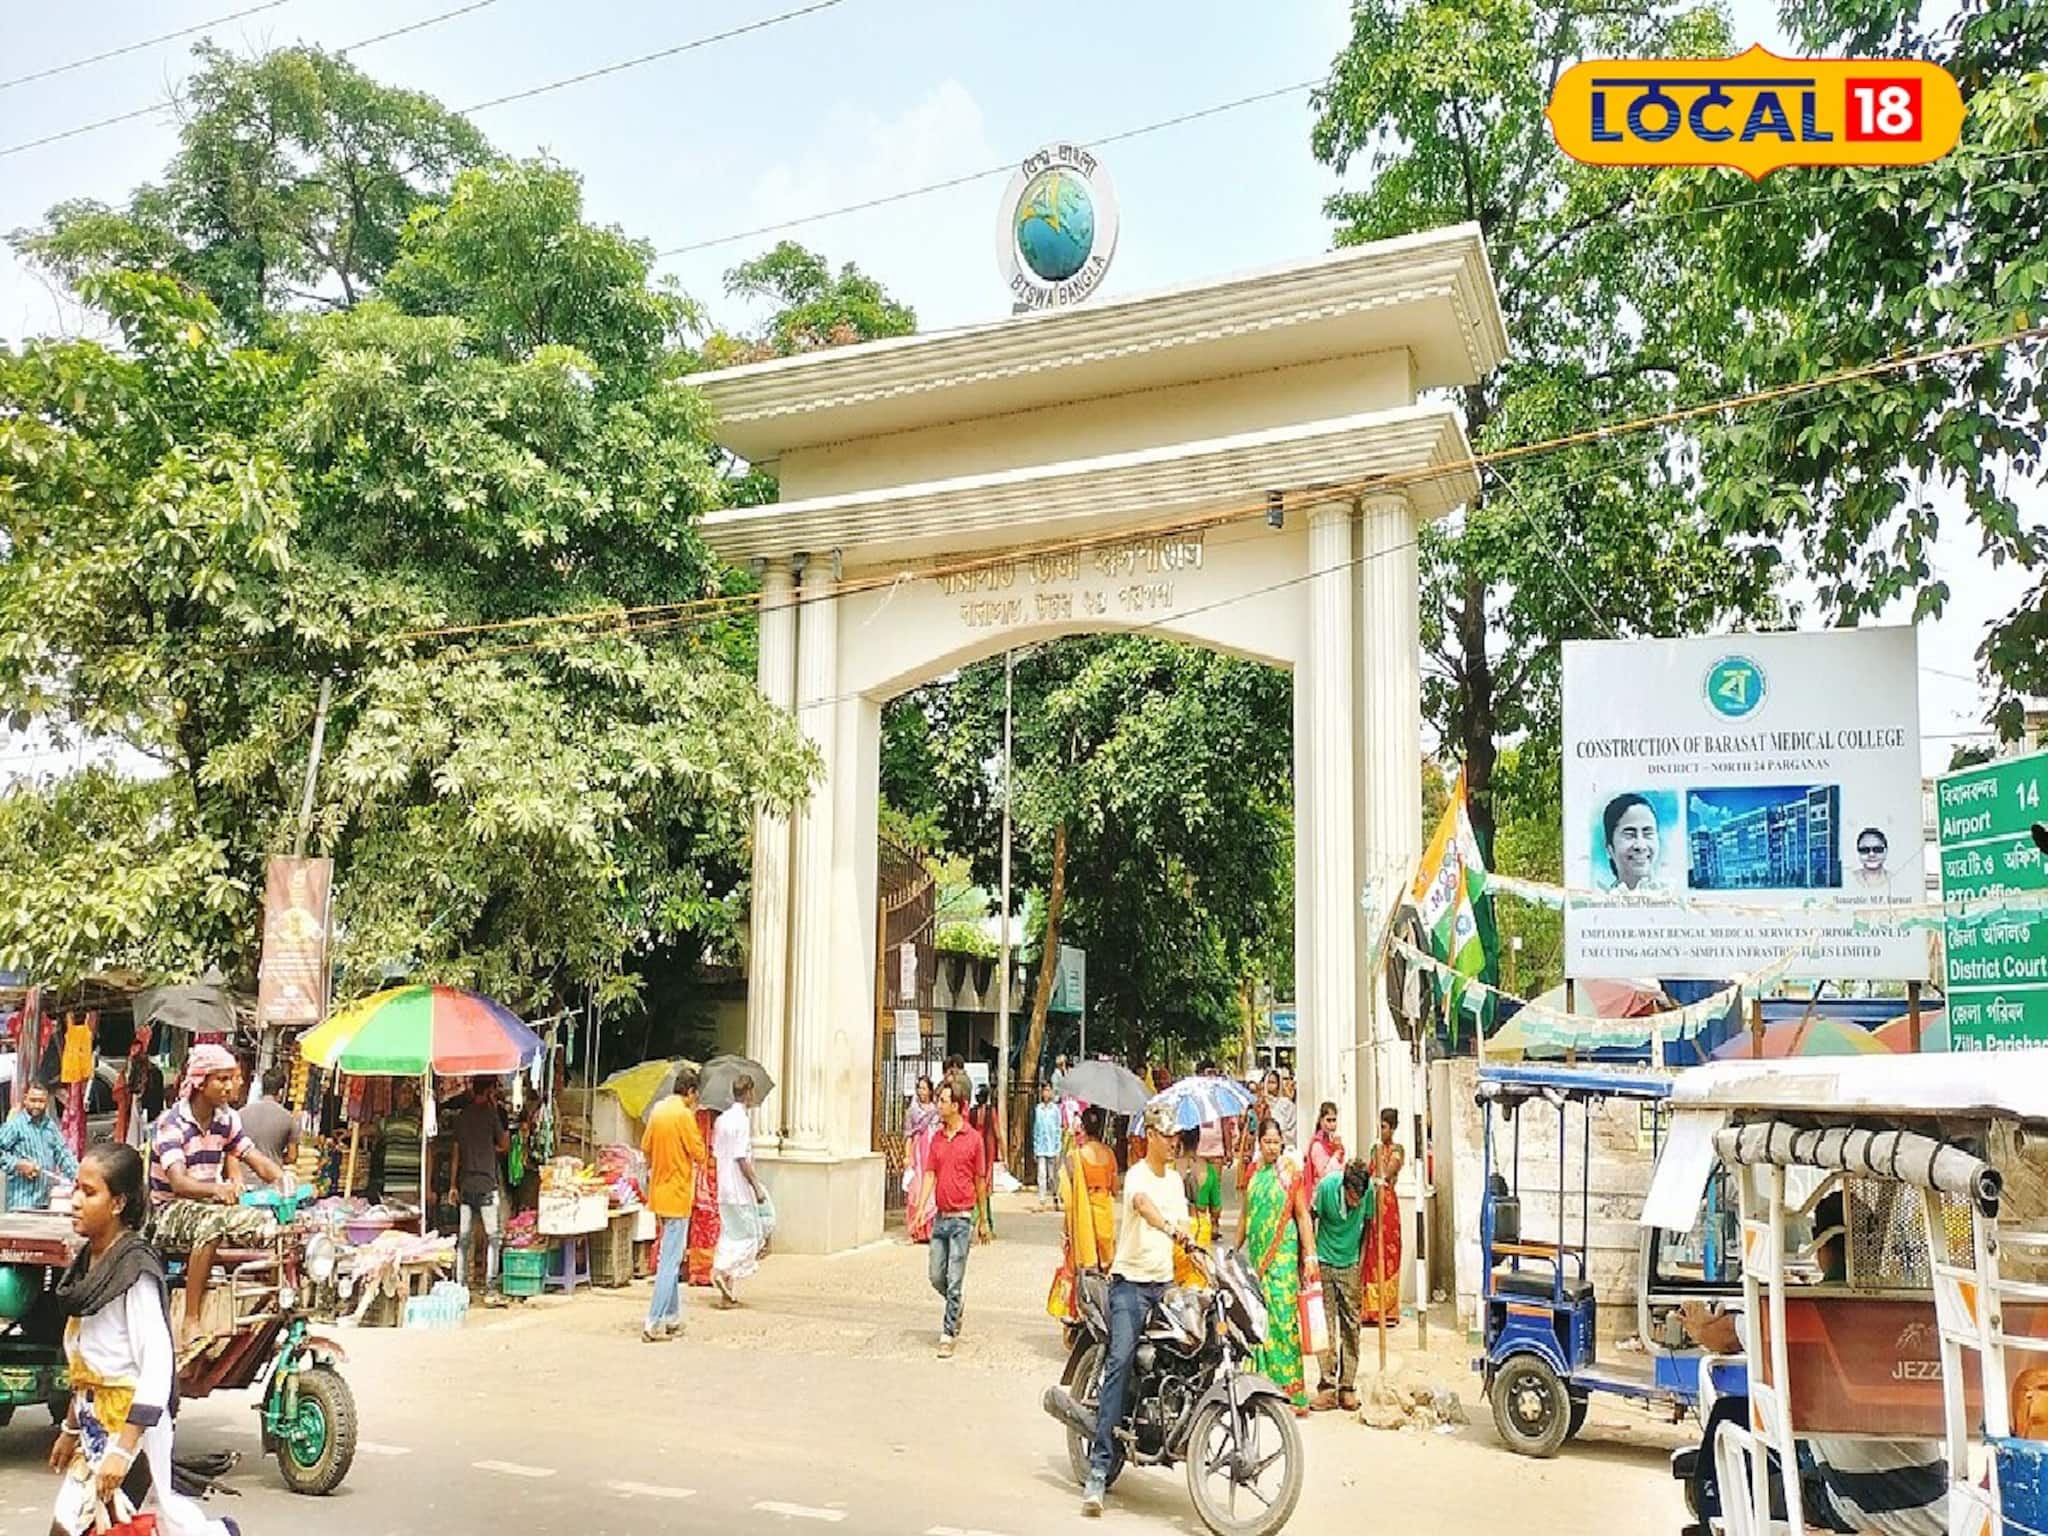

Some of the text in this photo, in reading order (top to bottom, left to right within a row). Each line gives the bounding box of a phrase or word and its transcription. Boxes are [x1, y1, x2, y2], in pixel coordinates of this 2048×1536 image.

[1059, 255, 1107, 306] BANGLA
[1576, 728, 1905, 759] CONSTRUCTION OF BARASAT MEDICAL COLLEGE
[1648, 761, 1700, 774] DISTRICT
[1712, 760, 1751, 773] NORTH
[1754, 760, 1766, 772] 24
[1767, 759, 1831, 772] PARGANAS
[2016, 778, 2040, 812] 14
[1942, 809, 1992, 840] Airport
[1666, 927, 1706, 939] BENGAL
[1709, 927, 1756, 938] MEDICAL
[1759, 927, 1808, 938] SERVICES
[1809, 927, 1888, 938] CRPORAON
[1948, 927, 1977, 950] জেলা
[1581, 945, 1638, 958] EXECUTING
[1640, 945, 1680, 958] AGENCY
[1690, 945, 1734, 957] SIMPLEX
[1836, 945, 1881, 957] LIMITED
[1950, 955, 2048, 981] District Court
[1951, 1003, 1982, 1025] জেলা
[1952, 1034, 1983, 1052] Zilla
